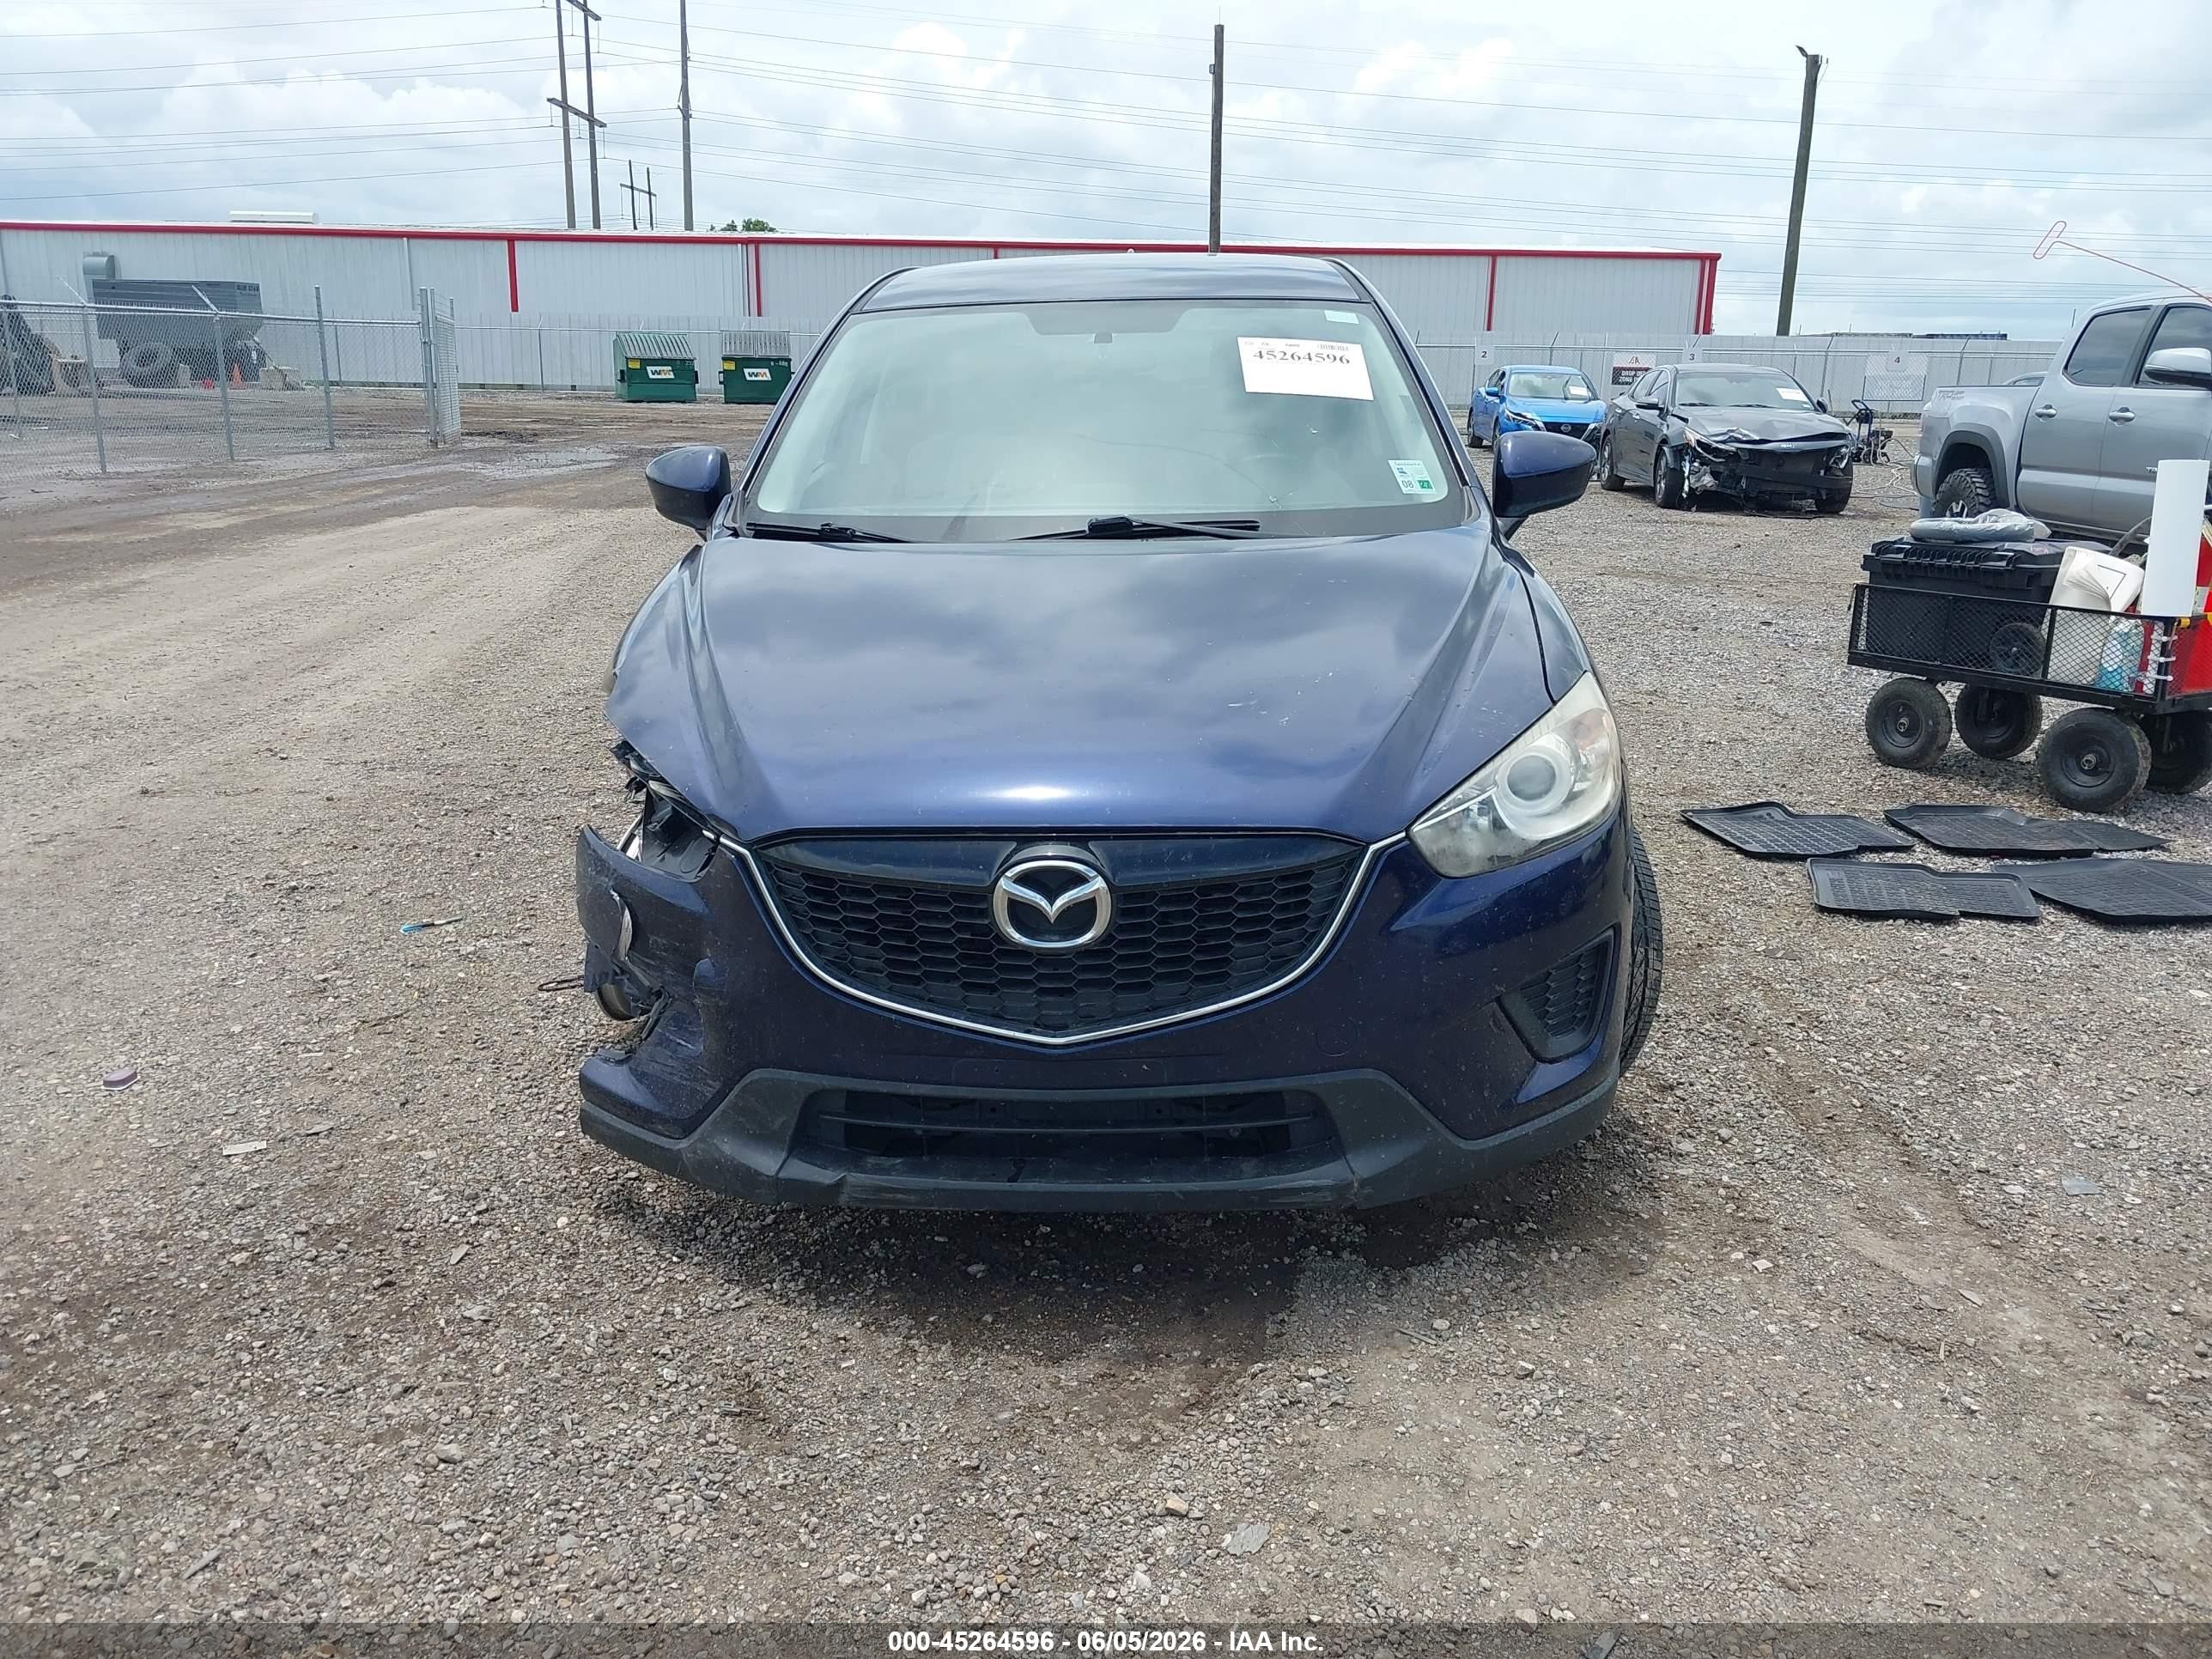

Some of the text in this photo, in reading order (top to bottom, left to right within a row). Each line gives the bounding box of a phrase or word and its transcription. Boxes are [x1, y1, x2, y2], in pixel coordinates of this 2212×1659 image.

[1253, 349, 1351, 365] 45264596
[1689, 353, 1696, 362] 3
[1893, 356, 1901, 364] 4
[1401, 480, 1414, 489] 08
